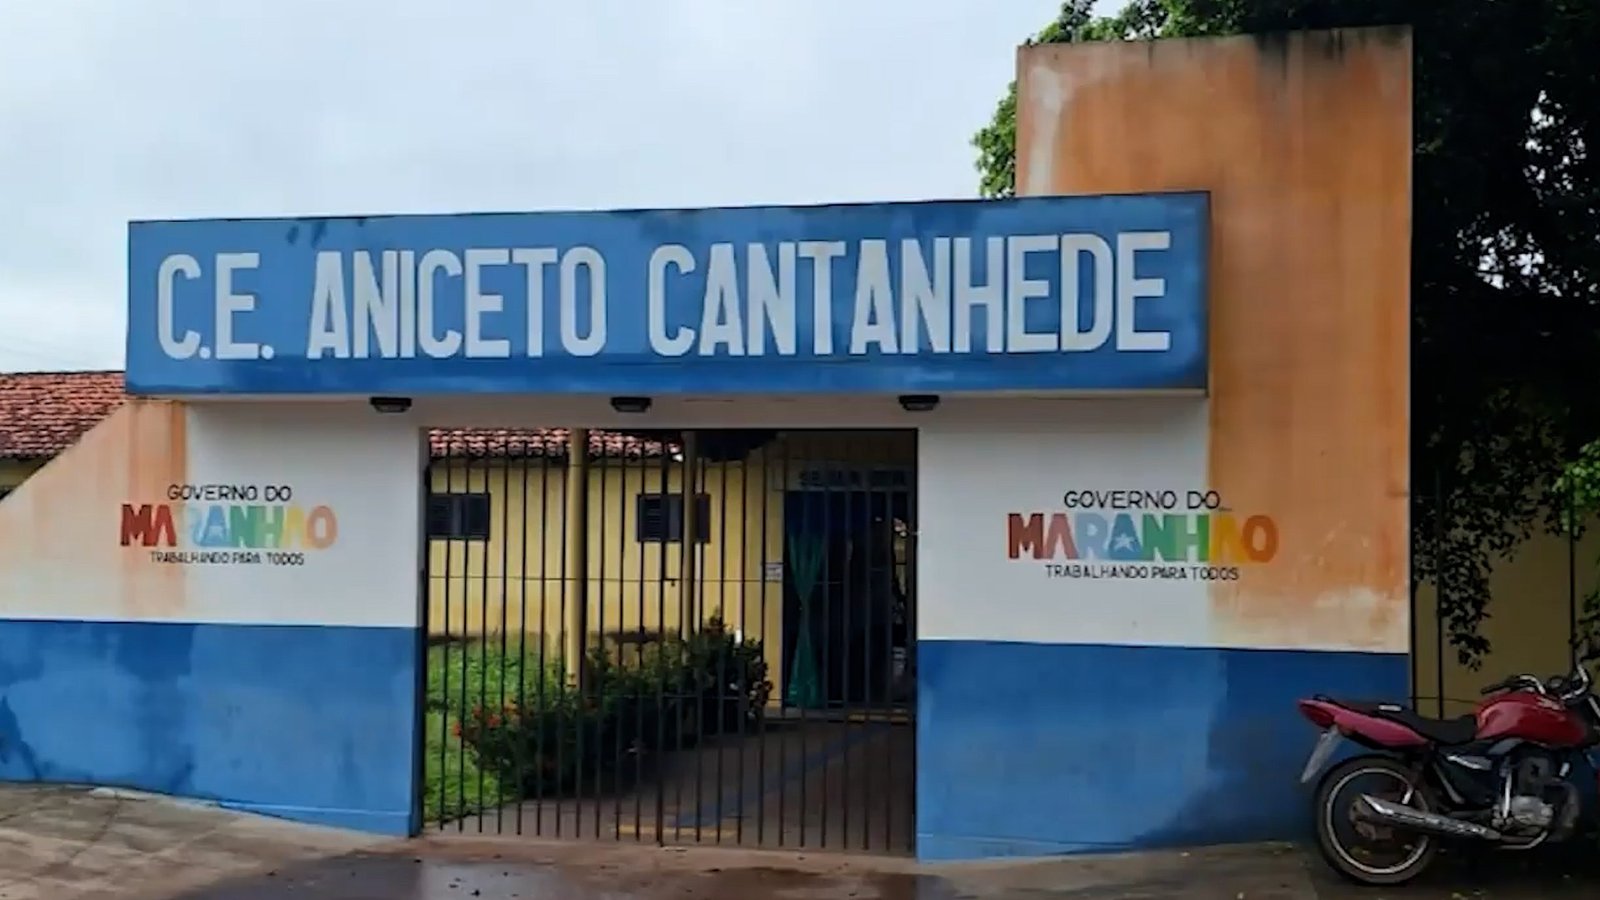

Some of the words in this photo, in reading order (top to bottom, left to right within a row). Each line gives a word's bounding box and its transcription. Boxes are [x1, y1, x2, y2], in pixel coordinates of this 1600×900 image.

[157, 252, 275, 361] C.E.
[306, 245, 608, 360] ANICETO
[648, 231, 1171, 357] CANTANHEDE
[167, 484, 259, 501] GOVERNO
[264, 485, 292, 502] DO
[1063, 491, 1178, 509] GOVERNO
[1186, 491, 1221, 510] DO
[150, 551, 230, 564] TRABALHANDO
[232, 552, 262, 565] PARA
[267, 553, 304, 566] TODOS
[1046, 564, 1149, 579] TRABALHANDO
[1151, 566, 1188, 580] PARA
[1191, 566, 1240, 581] TODOS
